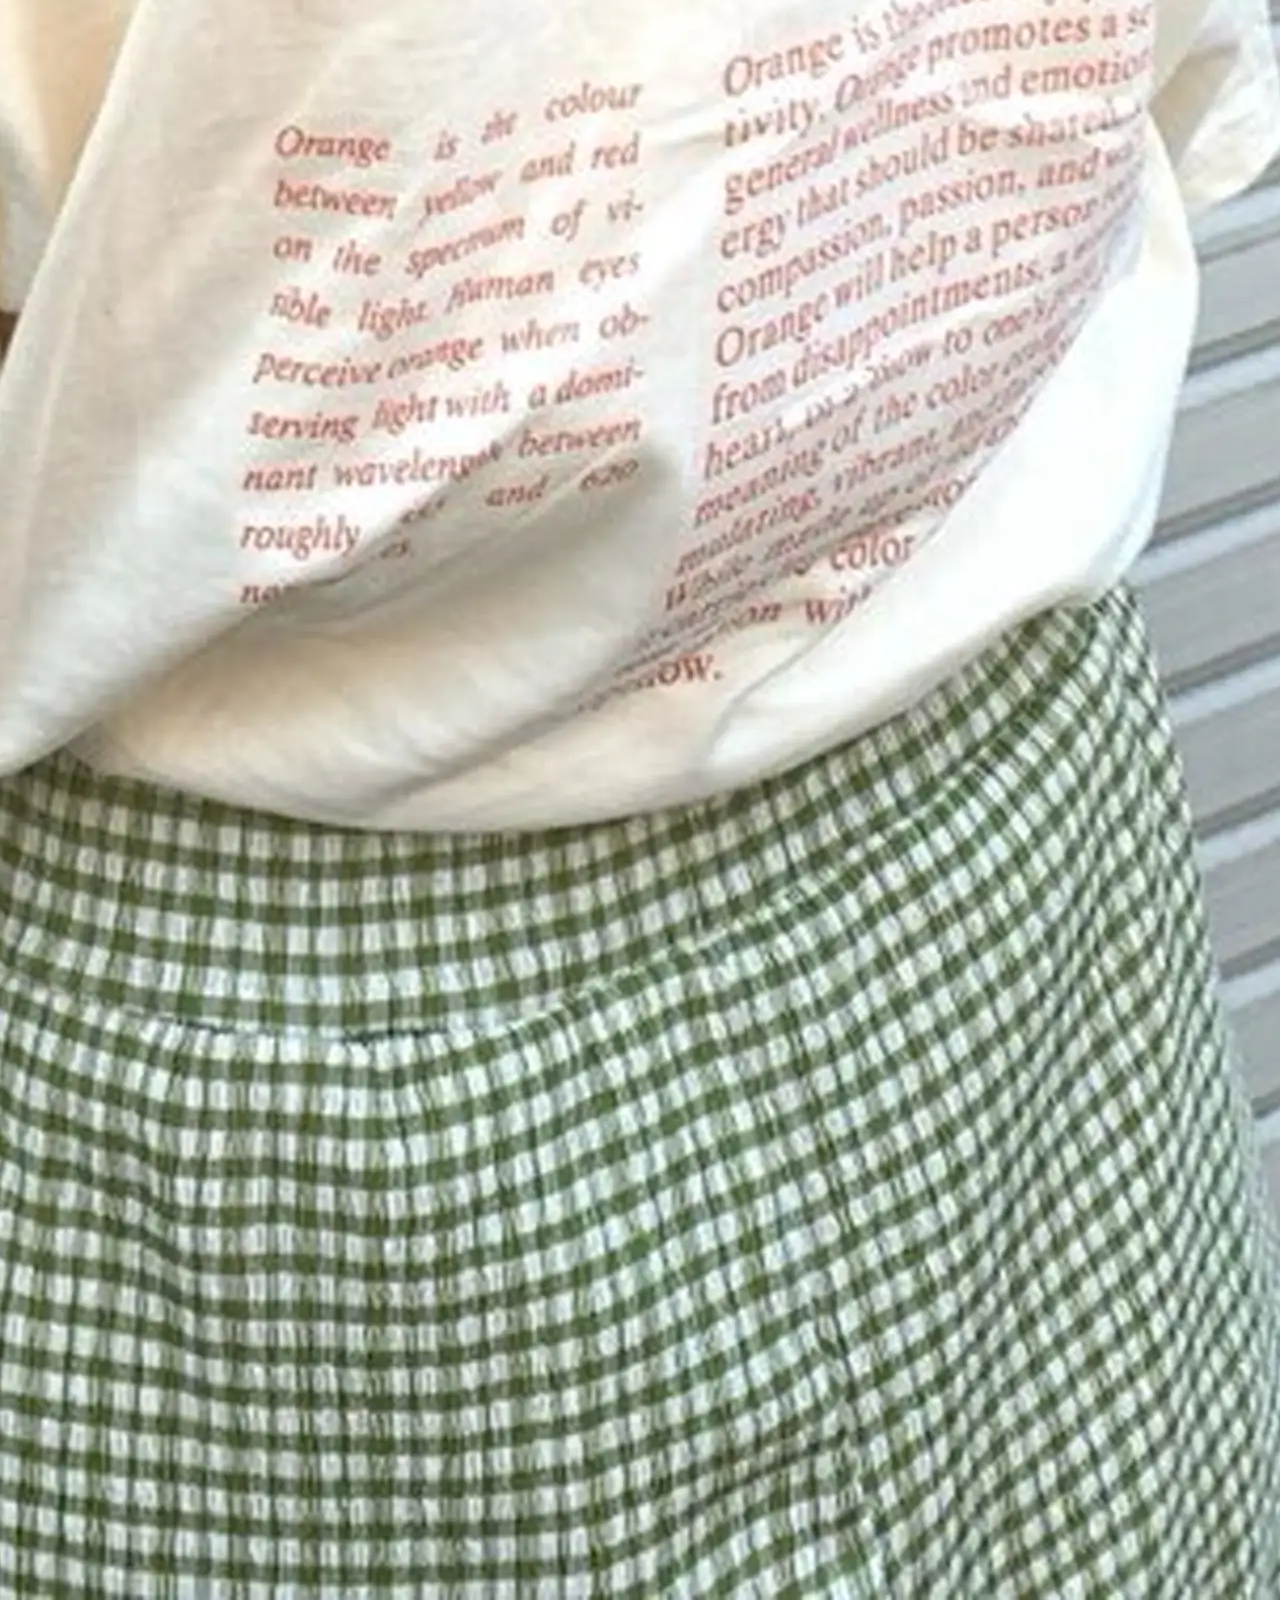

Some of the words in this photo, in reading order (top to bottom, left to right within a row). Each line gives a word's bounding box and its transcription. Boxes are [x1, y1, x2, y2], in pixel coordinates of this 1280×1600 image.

[723, 27, 846, 96] Orange
[851, 13, 880, 54] is
[926, 15, 1091, 74] promotes
[1101, 15, 1118, 40] a
[275, 125, 390, 169] Orange
[434, 129, 459, 162] is
[544, 82, 641, 123] colour
[723, 130, 838, 216] general
[844, 87, 954, 155] wellness
[962, 65, 1011, 108] and
[274, 179, 398, 220] between
[421, 168, 502, 227] yellow
[520, 140, 576, 185] and
[590, 131, 640, 171] red
[720, 211, 788, 258] ergy
[796, 176, 849, 228] that
[855, 126, 949, 197] should
[957, 115, 999, 155] be
[898, 164, 1025, 234] passion,
[1037, 148, 1098, 190] and
[273, 233, 312, 262] on
[332, 239, 381, 278] the
[405, 213, 525, 279] spectrum
[550, 197, 587, 243] of
[577, 251, 642, 292] eyes
[715, 304, 829, 367] Orange
[833, 255, 885, 308] will
[890, 224, 957, 283] help
[964, 224, 982, 254] a
[251, 352, 381, 389] perceive
[387, 336, 486, 380] orange
[501, 317, 581, 355] when
[599, 301, 651, 340] ob-
[944, 328, 973, 358] to
[246, 409, 359, 444] serving
[371, 394, 439, 436] light
[445, 380, 510, 418] with
[528, 382, 547, 410] a
[554, 356, 646, 404] domi-
[713, 371, 786, 425] from
[242, 462, 318, 492] nant
[517, 416, 641, 460] between
[694, 439, 827, 528] meaning
[832, 403, 868, 454] of
[874, 389, 917, 434] the
[925, 358, 1000, 412] color
[239, 515, 361, 561] roughly
[831, 531, 914, 572] color
